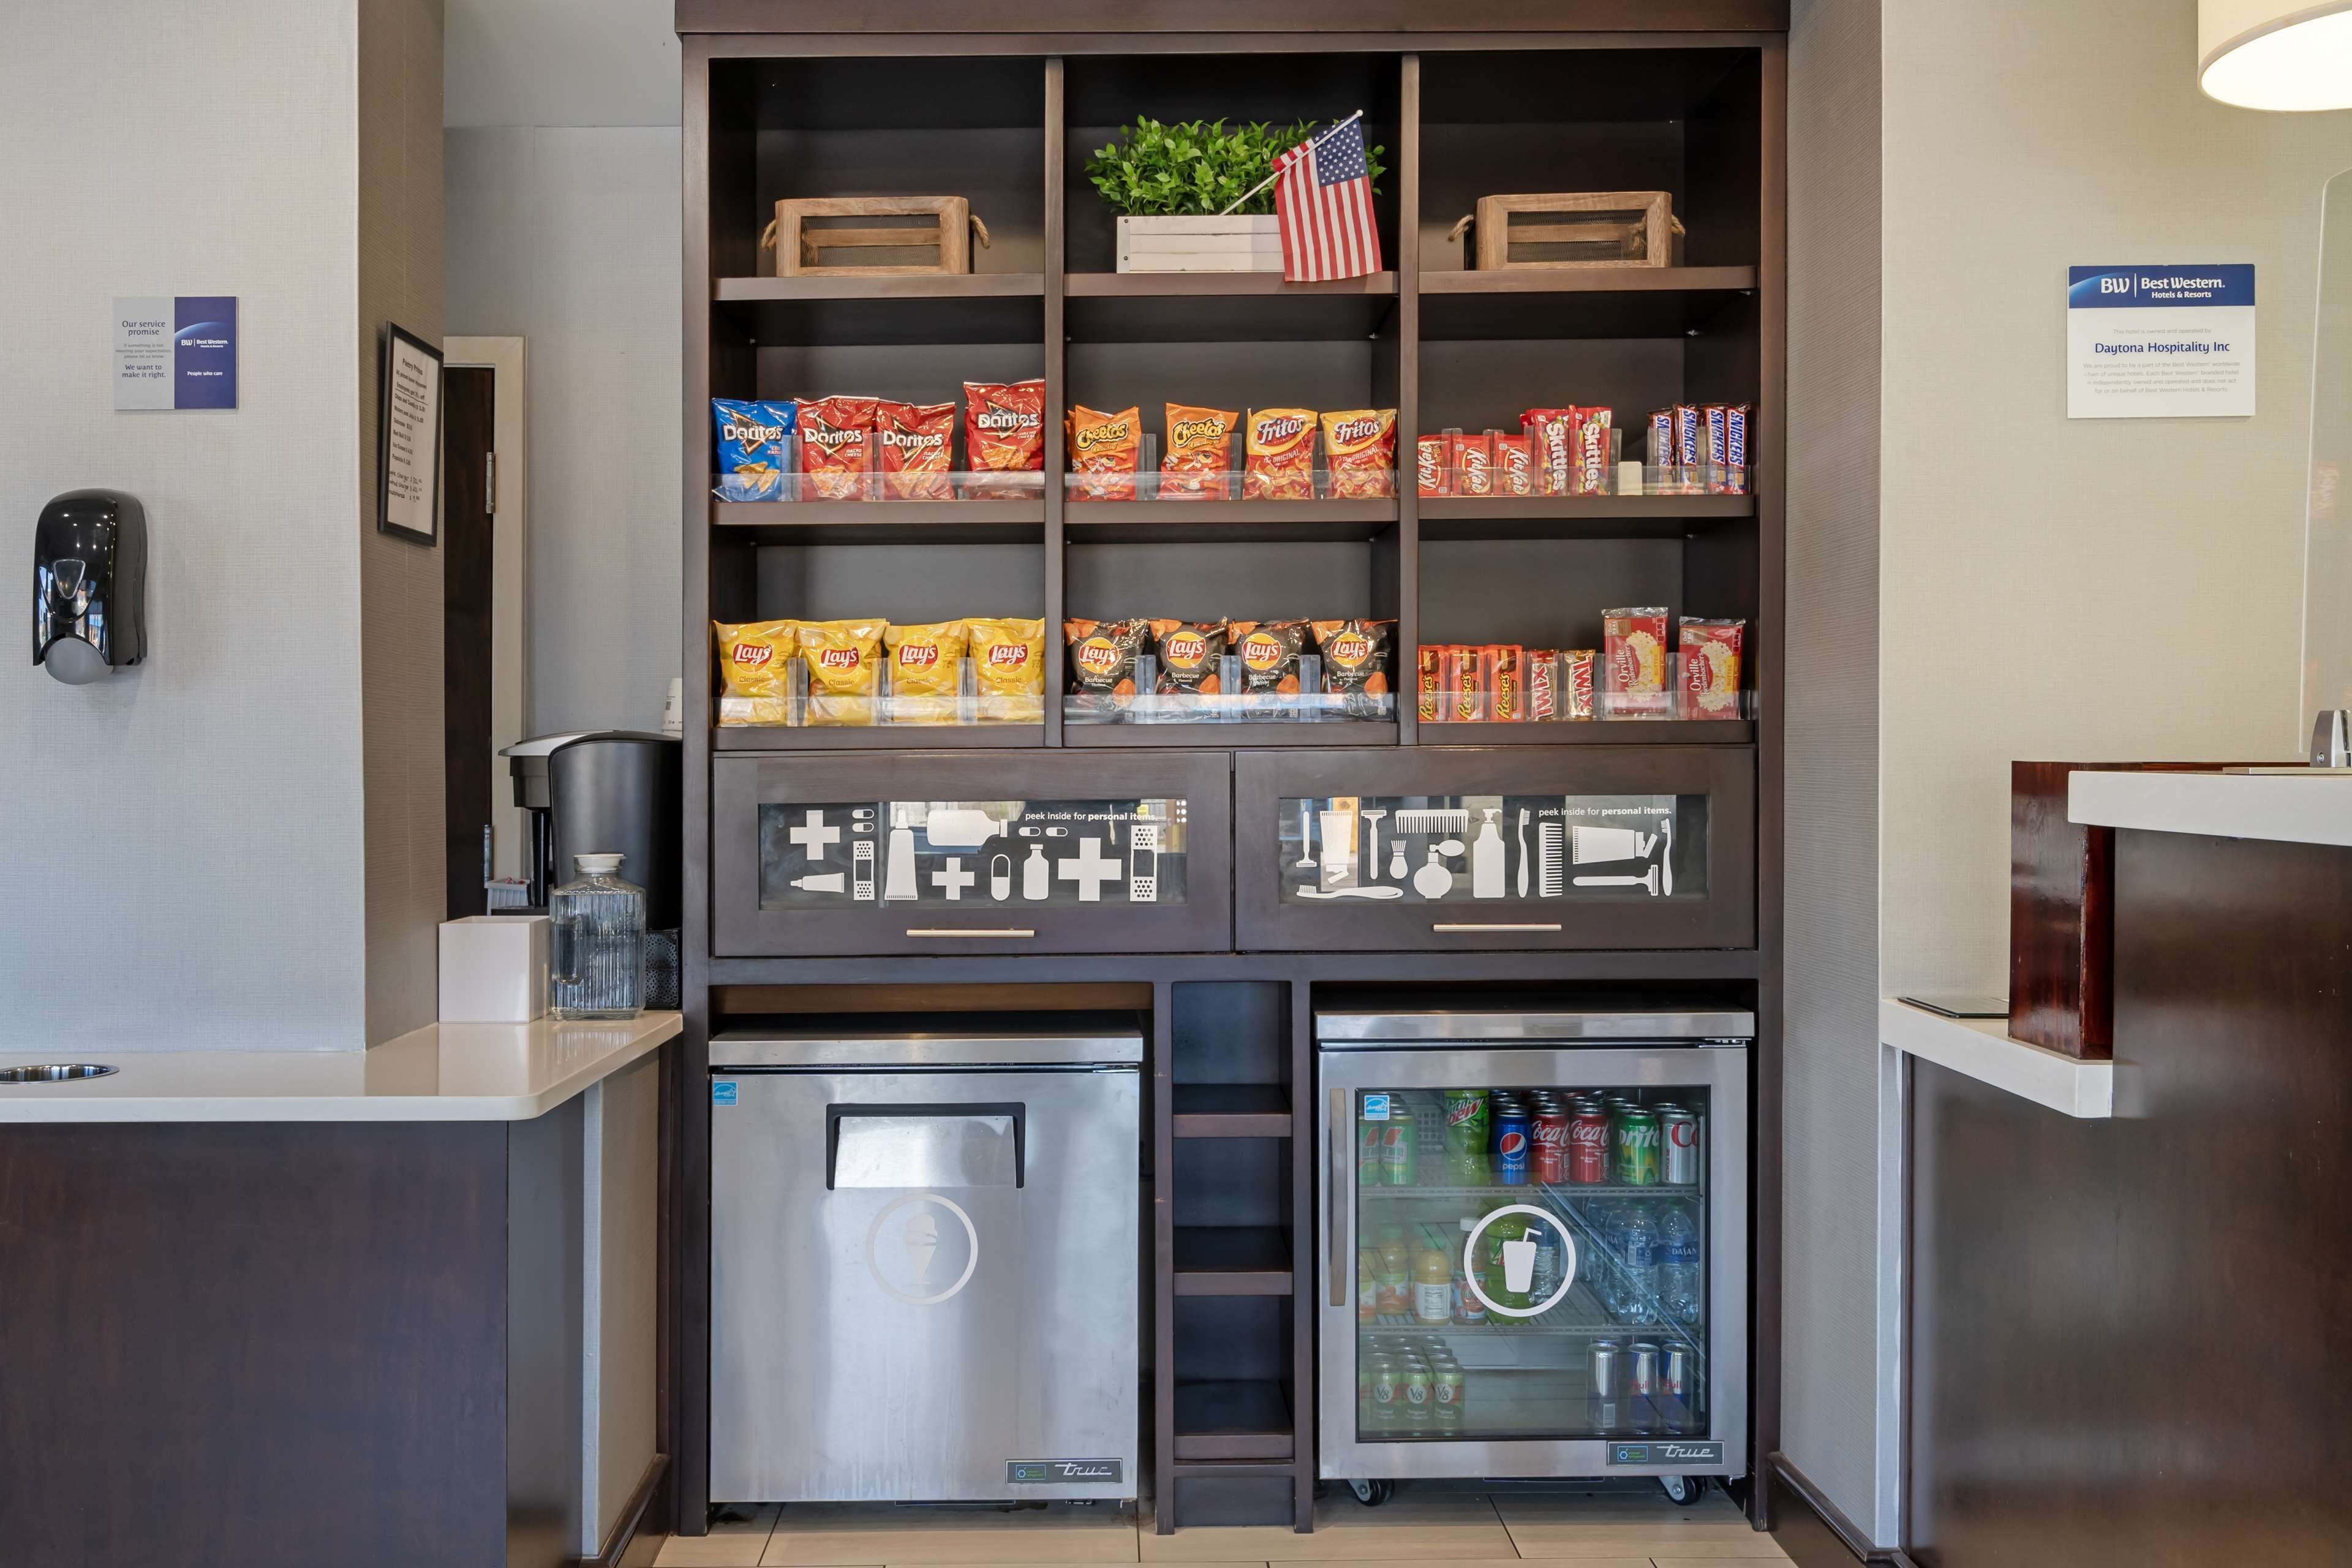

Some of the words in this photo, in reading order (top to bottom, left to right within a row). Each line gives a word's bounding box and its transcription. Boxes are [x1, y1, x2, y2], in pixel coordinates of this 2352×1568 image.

[2101, 277, 2130, 293] BW
[2141, 277, 2169, 289] Best
[128, 328, 160, 337] promise
[2095, 342, 2144, 356] Daytona
[2148, 341, 2209, 355] Hospitality
[2214, 341, 2230, 352] Inc
[978, 412, 1041, 429] Doritos
[723, 424, 784, 441] Doritos
[803, 428, 863, 444] Doritos
[883, 430, 943, 447] Doritos
[1076, 423, 1127, 449] Cheetos
[1172, 418, 1226, 446] Cheetos
[1257, 418, 1304, 444] Fritos
[1333, 420, 1380, 443] Fritos
[1683, 409, 1697, 464] SNICKERS
[1710, 410, 1725, 464] SNICKERS
[1729, 411, 1744, 466] SNICKERS
[1273, 449, 1300, 462] ORIGINAL
[1352, 445, 1379, 461] ORIGINAL
[1546, 423, 1568, 491] Skittles
[1582, 423, 1602, 491] Skittles
[735, 644, 772, 666] Lay's
[823, 647, 858, 669] Lay's
[901, 644, 937, 665] Lay's
[991, 644, 1027, 665] Lay's
[1169, 639, 1204, 660] Lay's
[1245, 641, 1279, 662] Lay's
[1616, 649, 1630, 682] Orville
[1689, 658, 1702, 692] Orville
[1571, 655, 1593, 716] TWIX
[1025, 812, 1045, 821] peek
[1048, 812, 1071, 820] inside
[1074, 812, 1087, 820] for
[1088, 812, 1128, 821] personal
[1130, 812, 1158, 821] items.
[1539, 808, 1559, 818] peek
[1602, 807, 1642, 816] personal
[1644, 806, 1672, 815] items.
[1502, 1162, 1525, 1172] pepsi
[1672, 1247, 1697, 1256] DASAN
[1376, 1385, 1390, 1401] V8
[1409, 1387, 1424, 1401] V8
[1437, 1385, 1450, 1401] V8
[1656, 1444, 1714, 1458] true
[1055, 1461, 1112, 1476] true
